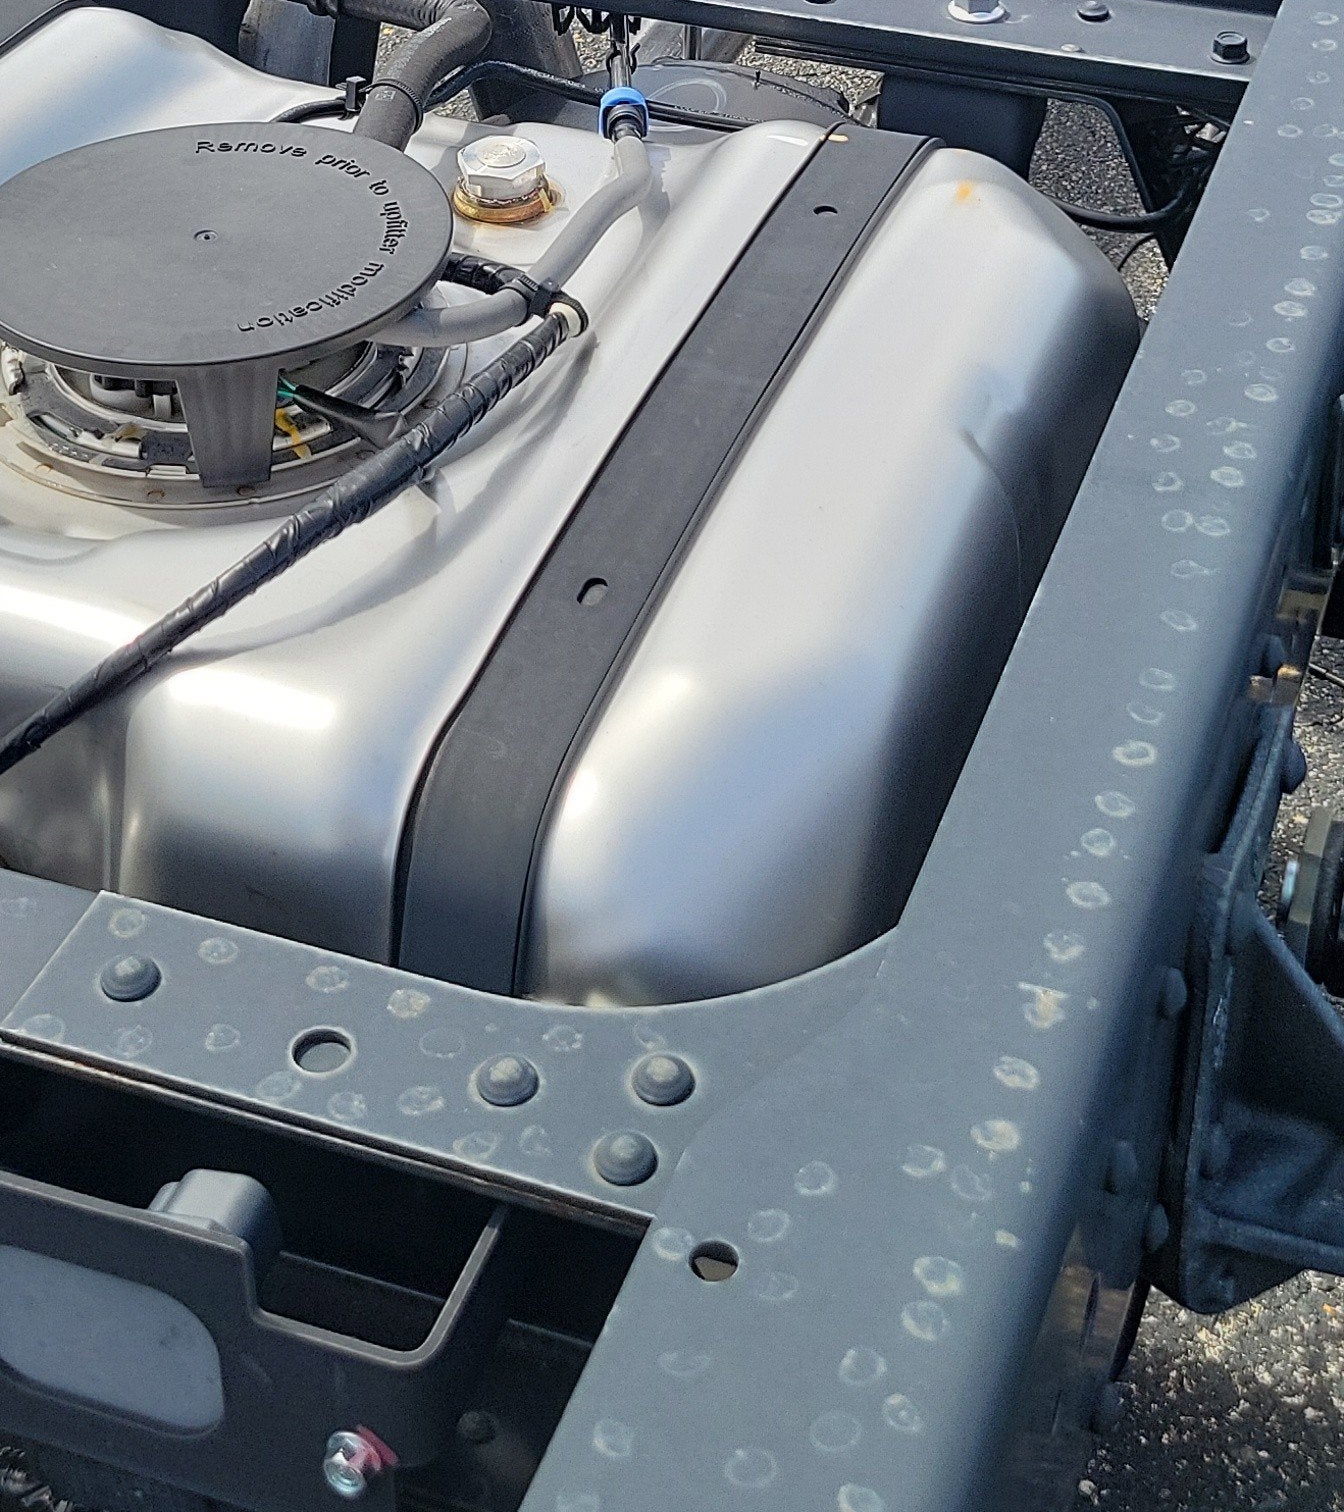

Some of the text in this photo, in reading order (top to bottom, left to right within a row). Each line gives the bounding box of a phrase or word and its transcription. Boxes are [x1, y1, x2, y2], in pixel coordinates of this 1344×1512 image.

[195, 140, 409, 332] Remove prior to upfitter modification
